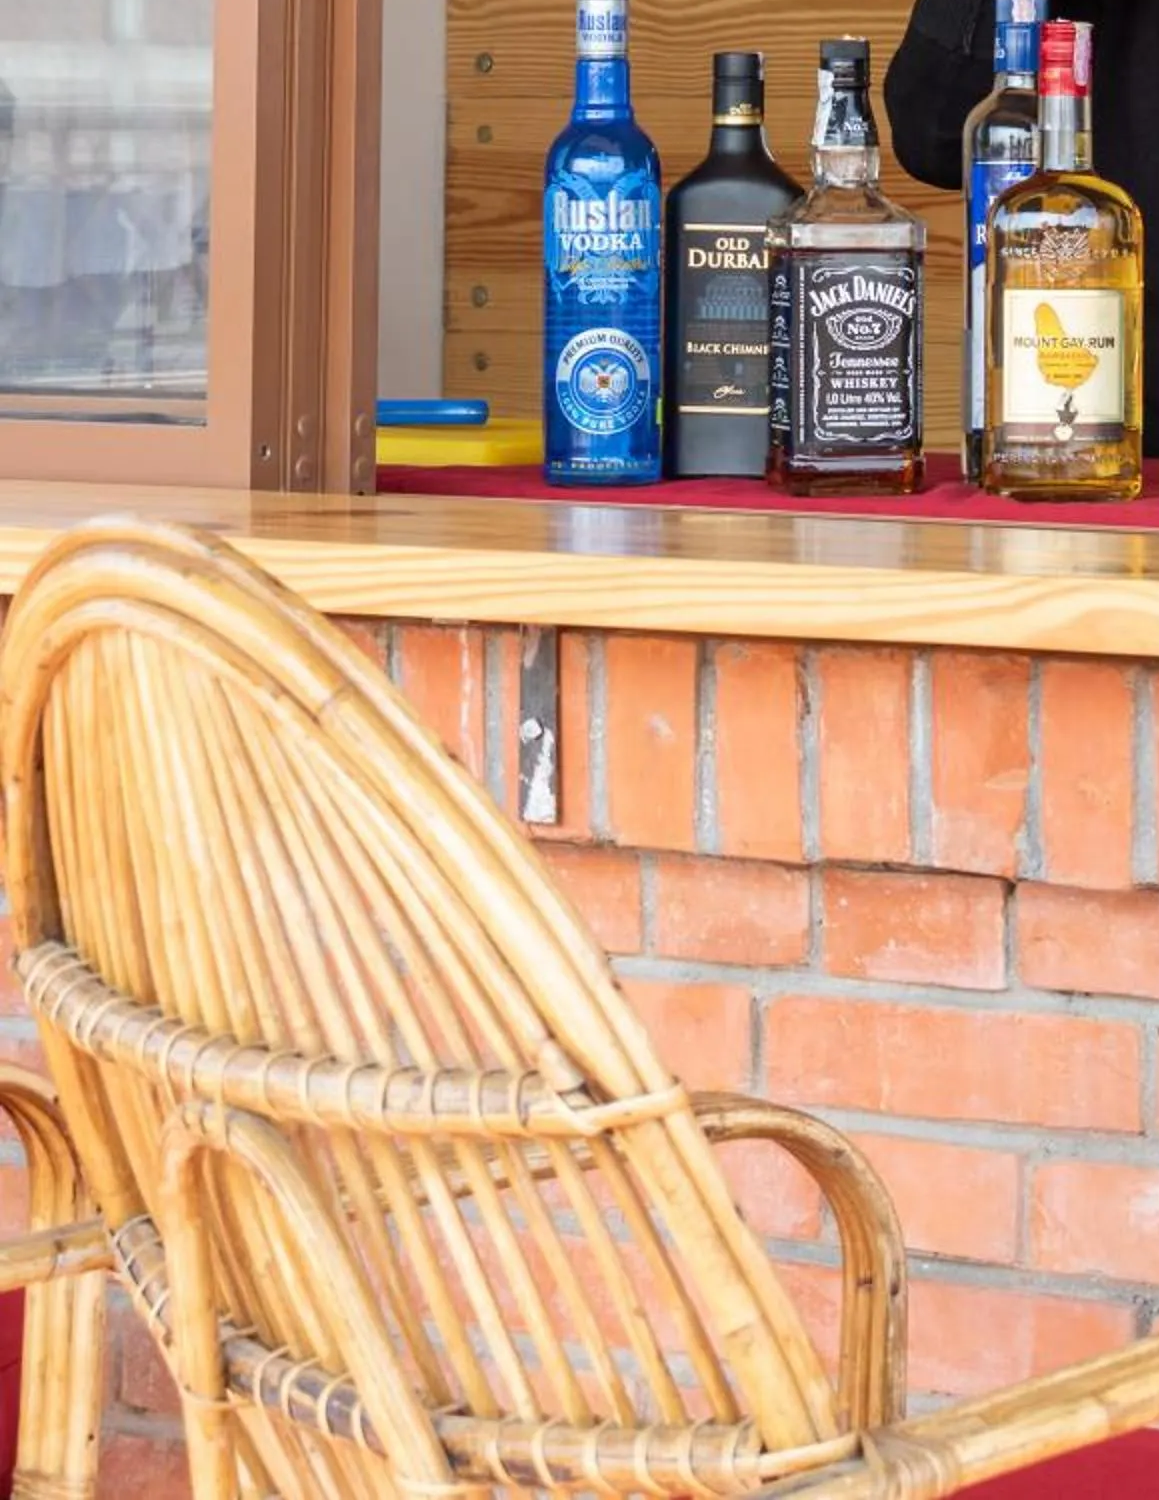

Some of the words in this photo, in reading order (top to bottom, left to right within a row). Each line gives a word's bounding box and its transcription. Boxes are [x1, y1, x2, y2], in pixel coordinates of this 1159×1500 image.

[553, 190, 651, 232] Ruslan
[560, 233, 645, 252] VODKA
[715, 237, 750, 251] OLD
[808, 283, 853, 317] JACK
[852, 275, 918, 318] DANIEL'S
[563, 333, 607, 364] PREMIUM
[687, 341, 721, 354] BLACK
[723, 343, 769, 356] CHIMN
[1013, 336, 1058, 349] MOUNT
[1060, 337, 1085, 349] GAY
[1087, 336, 1115, 349] RUM
[830, 377, 899, 389] WHISKEY
